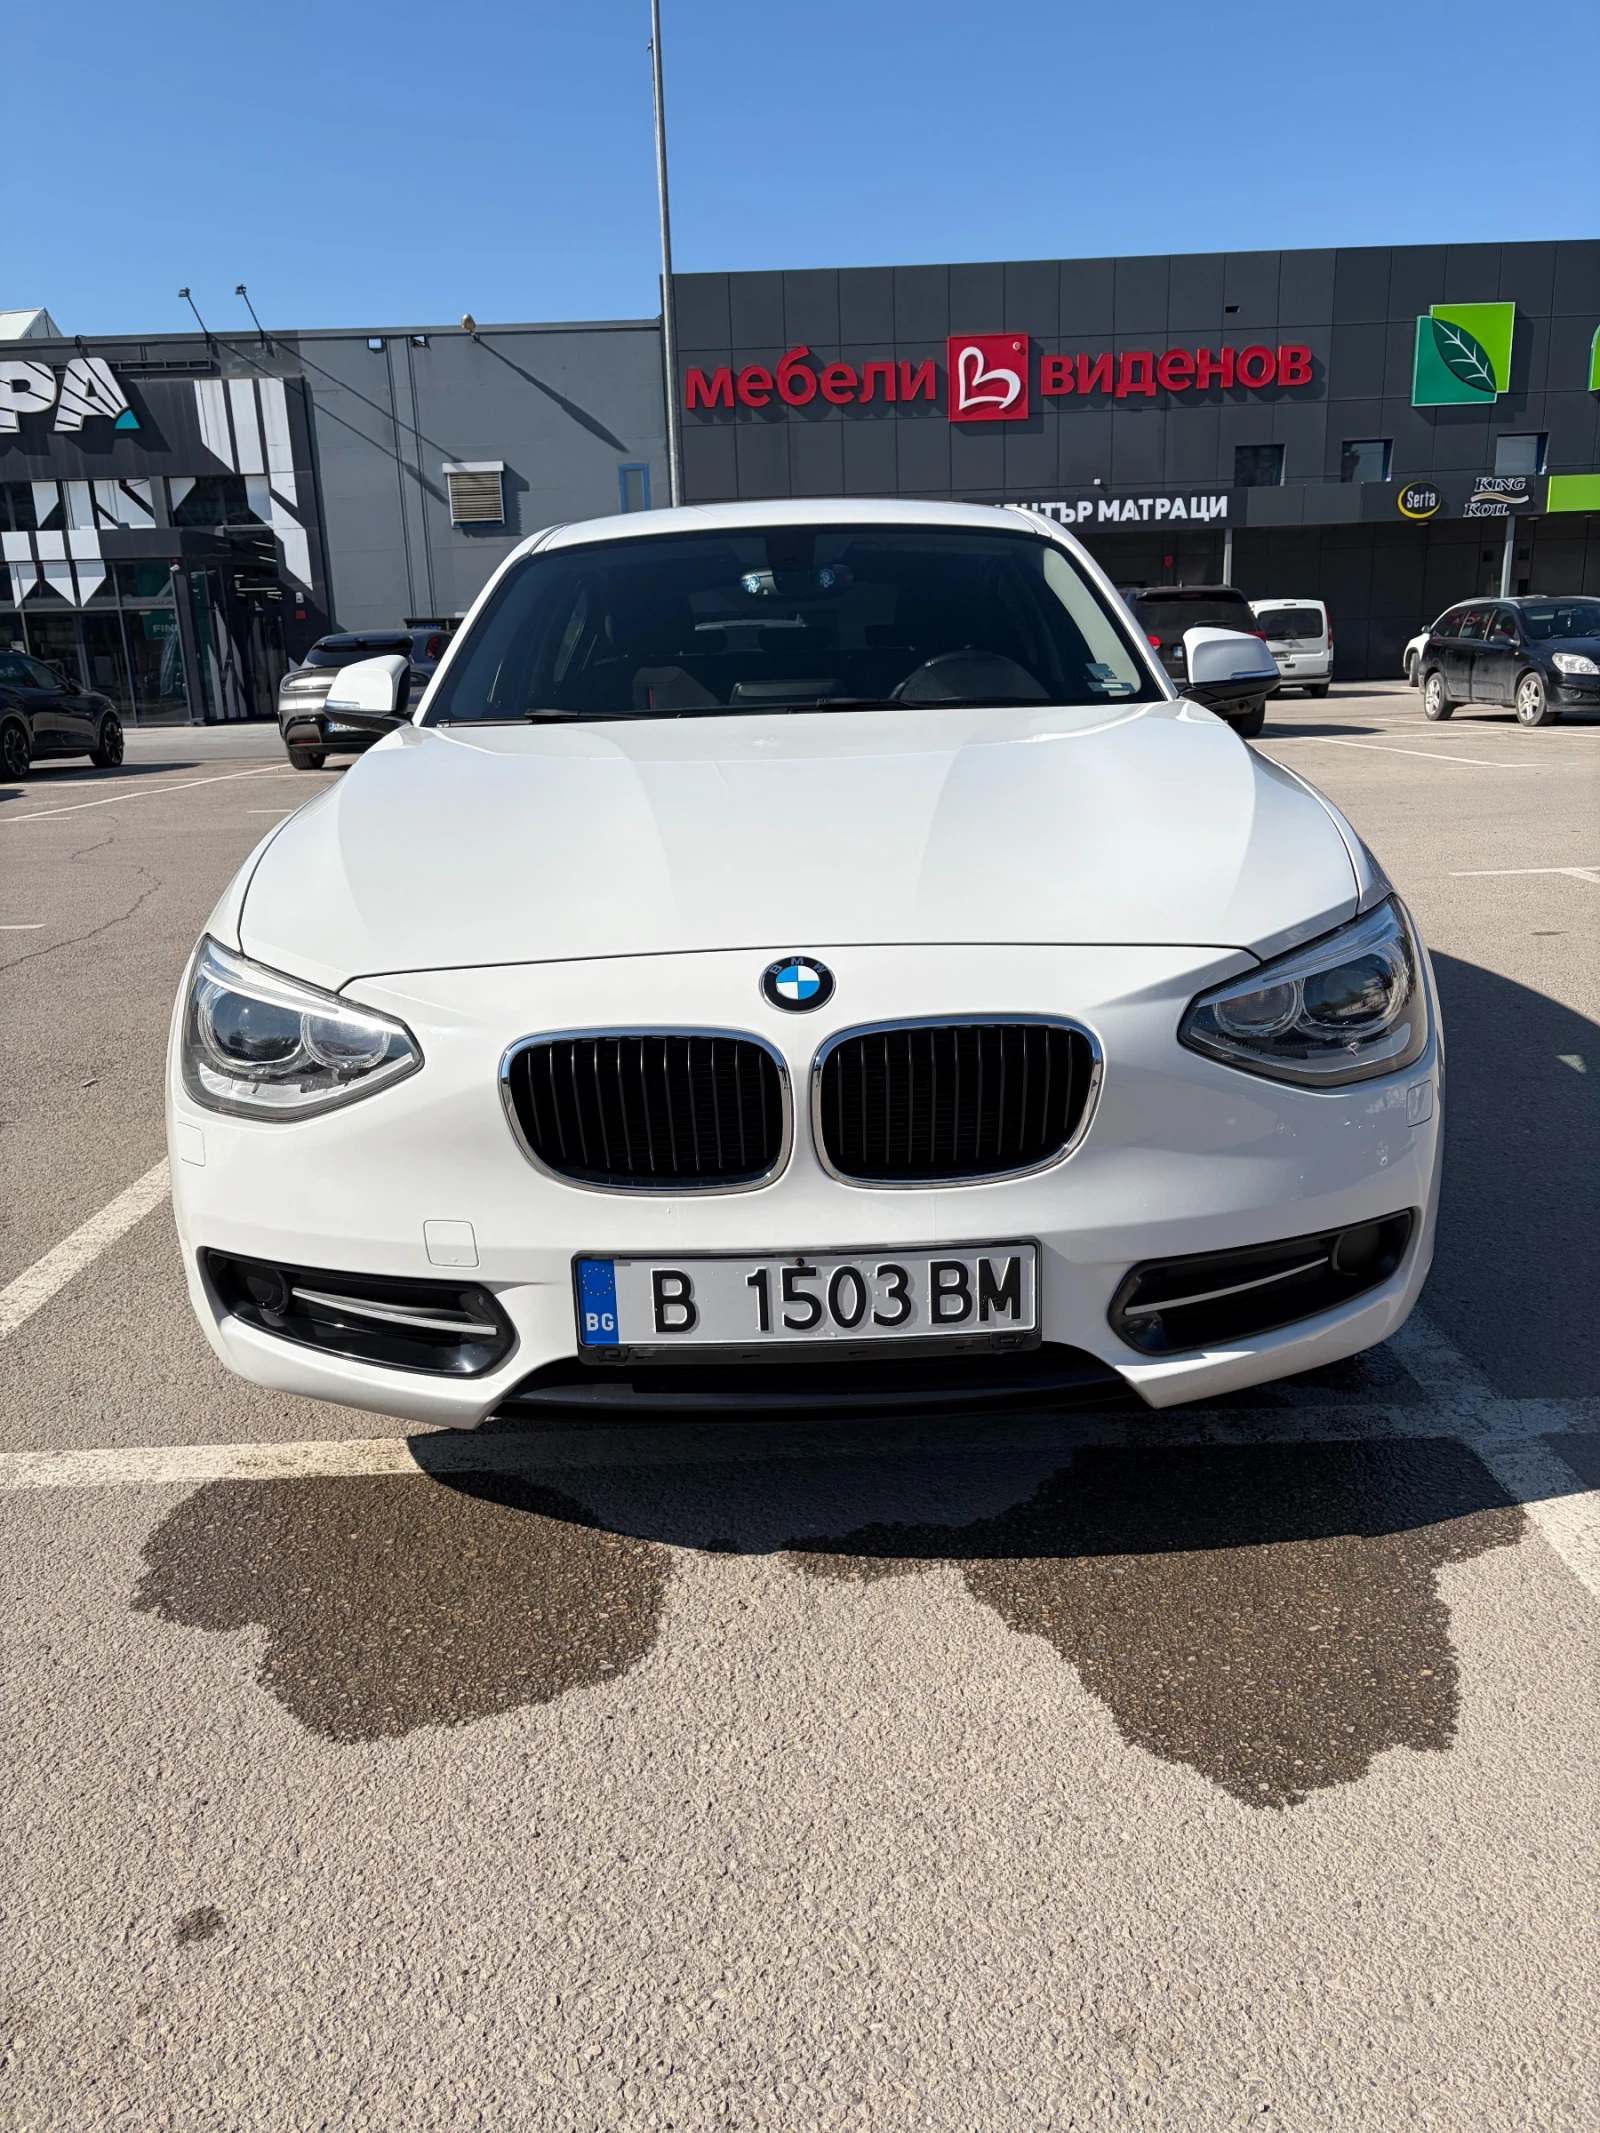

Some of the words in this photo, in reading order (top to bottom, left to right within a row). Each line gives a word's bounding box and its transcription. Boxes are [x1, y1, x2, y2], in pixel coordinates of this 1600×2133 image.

[685, 345, 936, 409] мебели
[1040, 345, 1313, 398] виденов
[1097, 495, 1228, 522] МАТРАЦИ
[1406, 490, 1436, 508] Serta
[768, 957, 828, 975] BMW
[651, 1267, 699, 1333] B
[745, 1262, 912, 1332] 1503
[928, 1256, 1021, 1325] BM
[585, 1312, 615, 1332] BG
